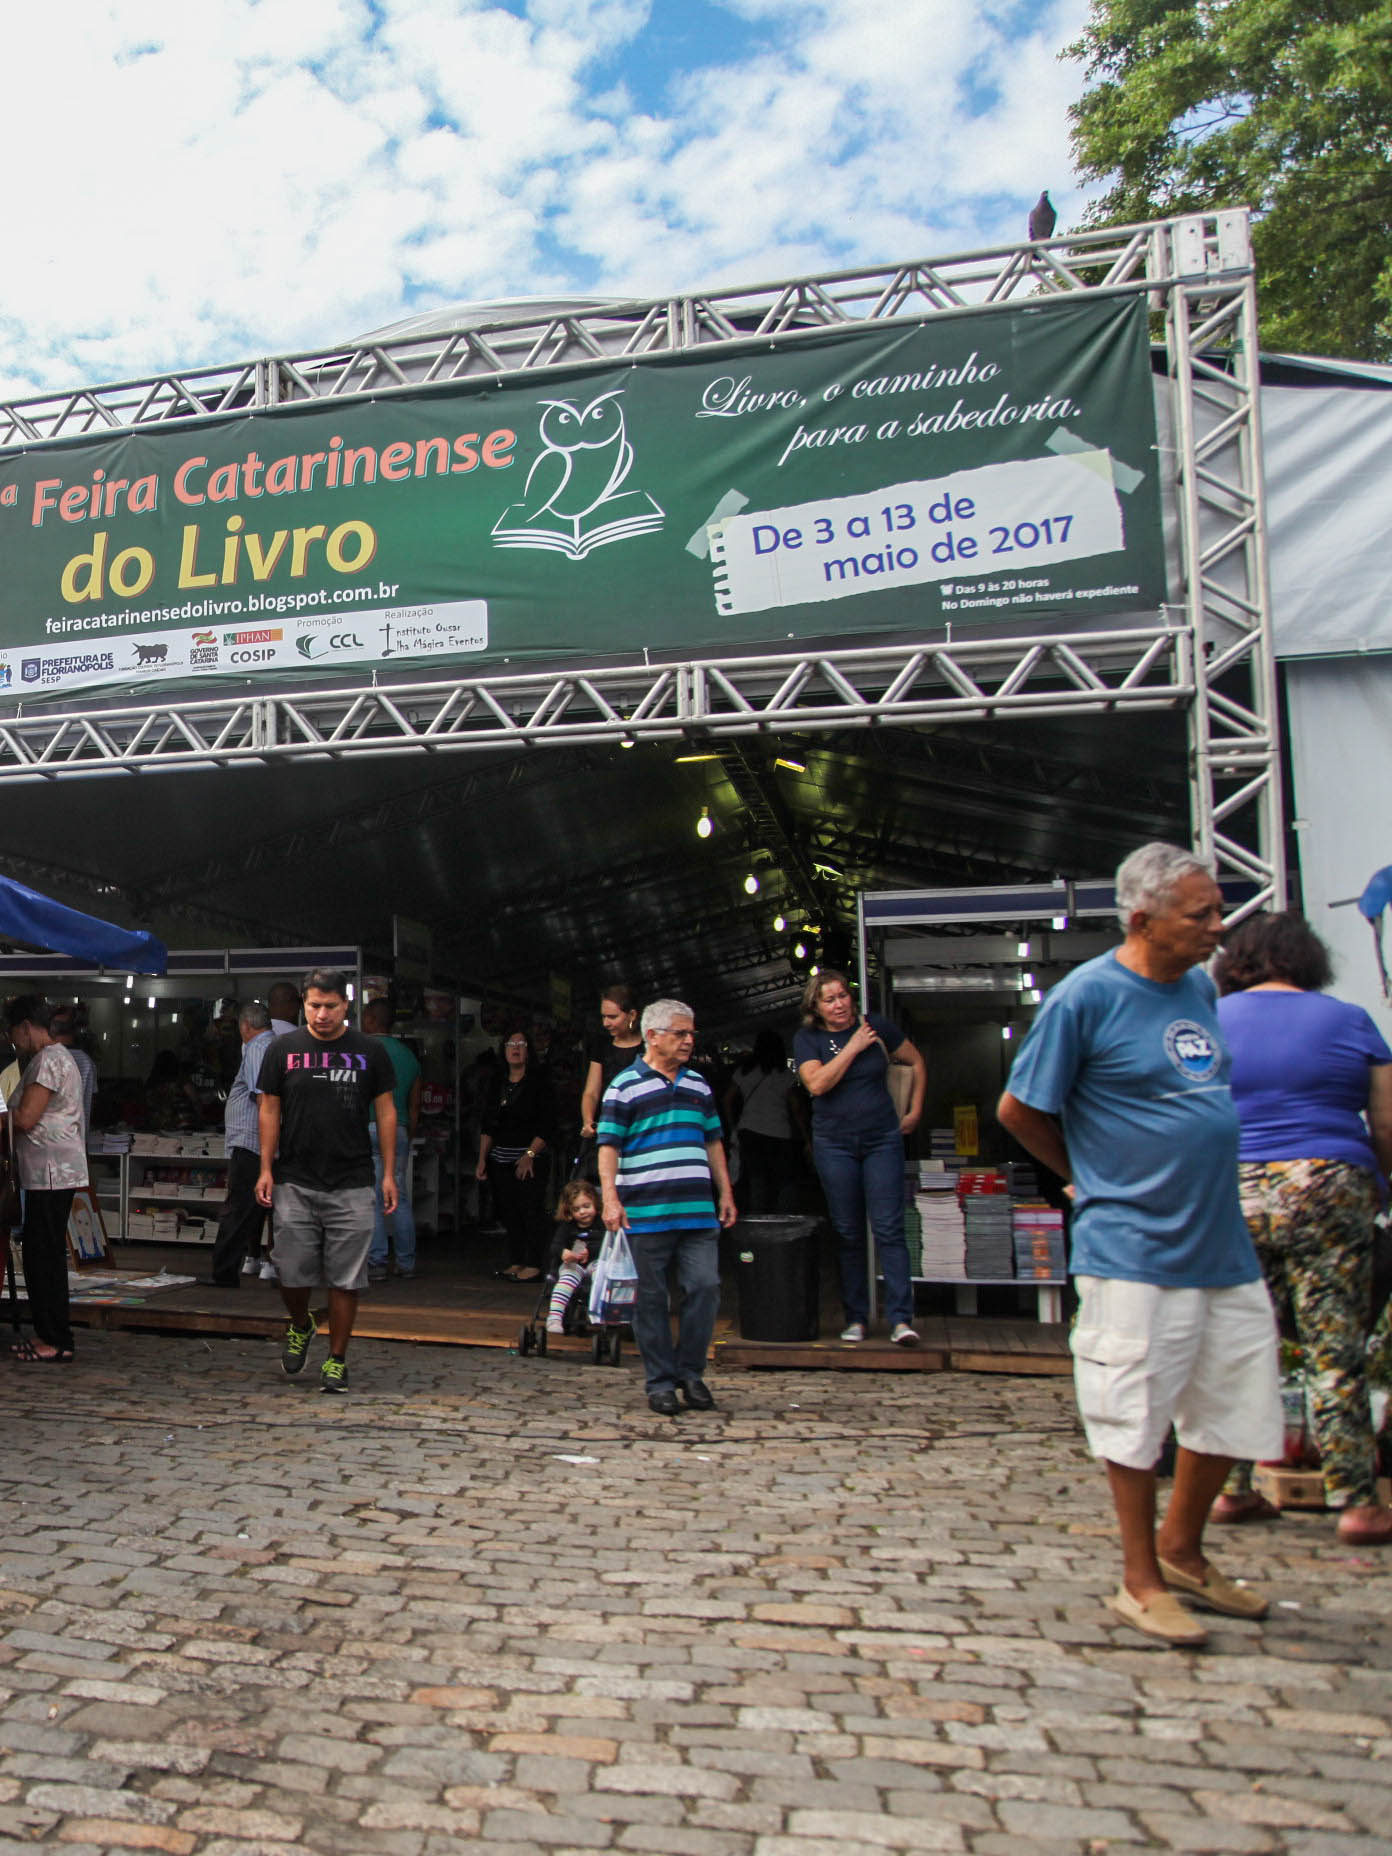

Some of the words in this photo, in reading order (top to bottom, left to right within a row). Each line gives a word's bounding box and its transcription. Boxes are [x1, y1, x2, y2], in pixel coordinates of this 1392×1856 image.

[694, 374, 807, 419] Livro,
[823, 383, 845, 400] o
[852, 351, 1002, 398] caminho
[777, 421, 867, 467] para
[876, 417, 901, 441] a
[907, 391, 1082, 438] sabedoria.
[31, 468, 159, 526] Feira
[173, 428, 519, 507] Catarinense
[751, 522, 803, 556] De
[815, 518, 834, 545] 3
[846, 516, 872, 540] a
[880, 503, 917, 533] 13
[928, 491, 976, 523] de
[823, 543, 918, 583] maio
[931, 532, 980, 564] de
[991, 514, 1075, 555] 2017
[60, 532, 155, 604] do
[178, 514, 377, 591] Livro
[955, 584, 976, 595] Das
[978, 584, 985, 592] 9
[987, 581, 1000, 592] às
[1002, 580, 1016, 590] 20
[1018, 577, 1050, 589] horas
[942, 600, 958, 610] No
[960, 595, 1009, 609] Domingo
[1012, 593, 1032, 604] não
[1035, 589, 1073, 602] haverá
[1075, 584, 1139, 600] expediente
[45, 581, 400, 634] feiracatarinensedolivro.blogspot.com.br
[384, 607, 434, 620] Realização
[297, 616, 343, 628] Promoção
[436, 623, 461, 633] Ousar
[236, 631, 271, 644] IPHAN
[329, 633, 364, 649] CCL
[414, 637, 444, 649] Mágica
[449, 635, 485, 647] Eventos
[190, 646, 219, 655] GOVERNO
[230, 649, 276, 664] COSIP
[41, 660, 114, 676] FLORIANÓPOLIS
[42, 654, 97, 668] PREFEITURA
[100, 653, 113, 662] DE
[41, 675, 61, 684] SESP
[287, 1052, 368, 1070] GUESS
